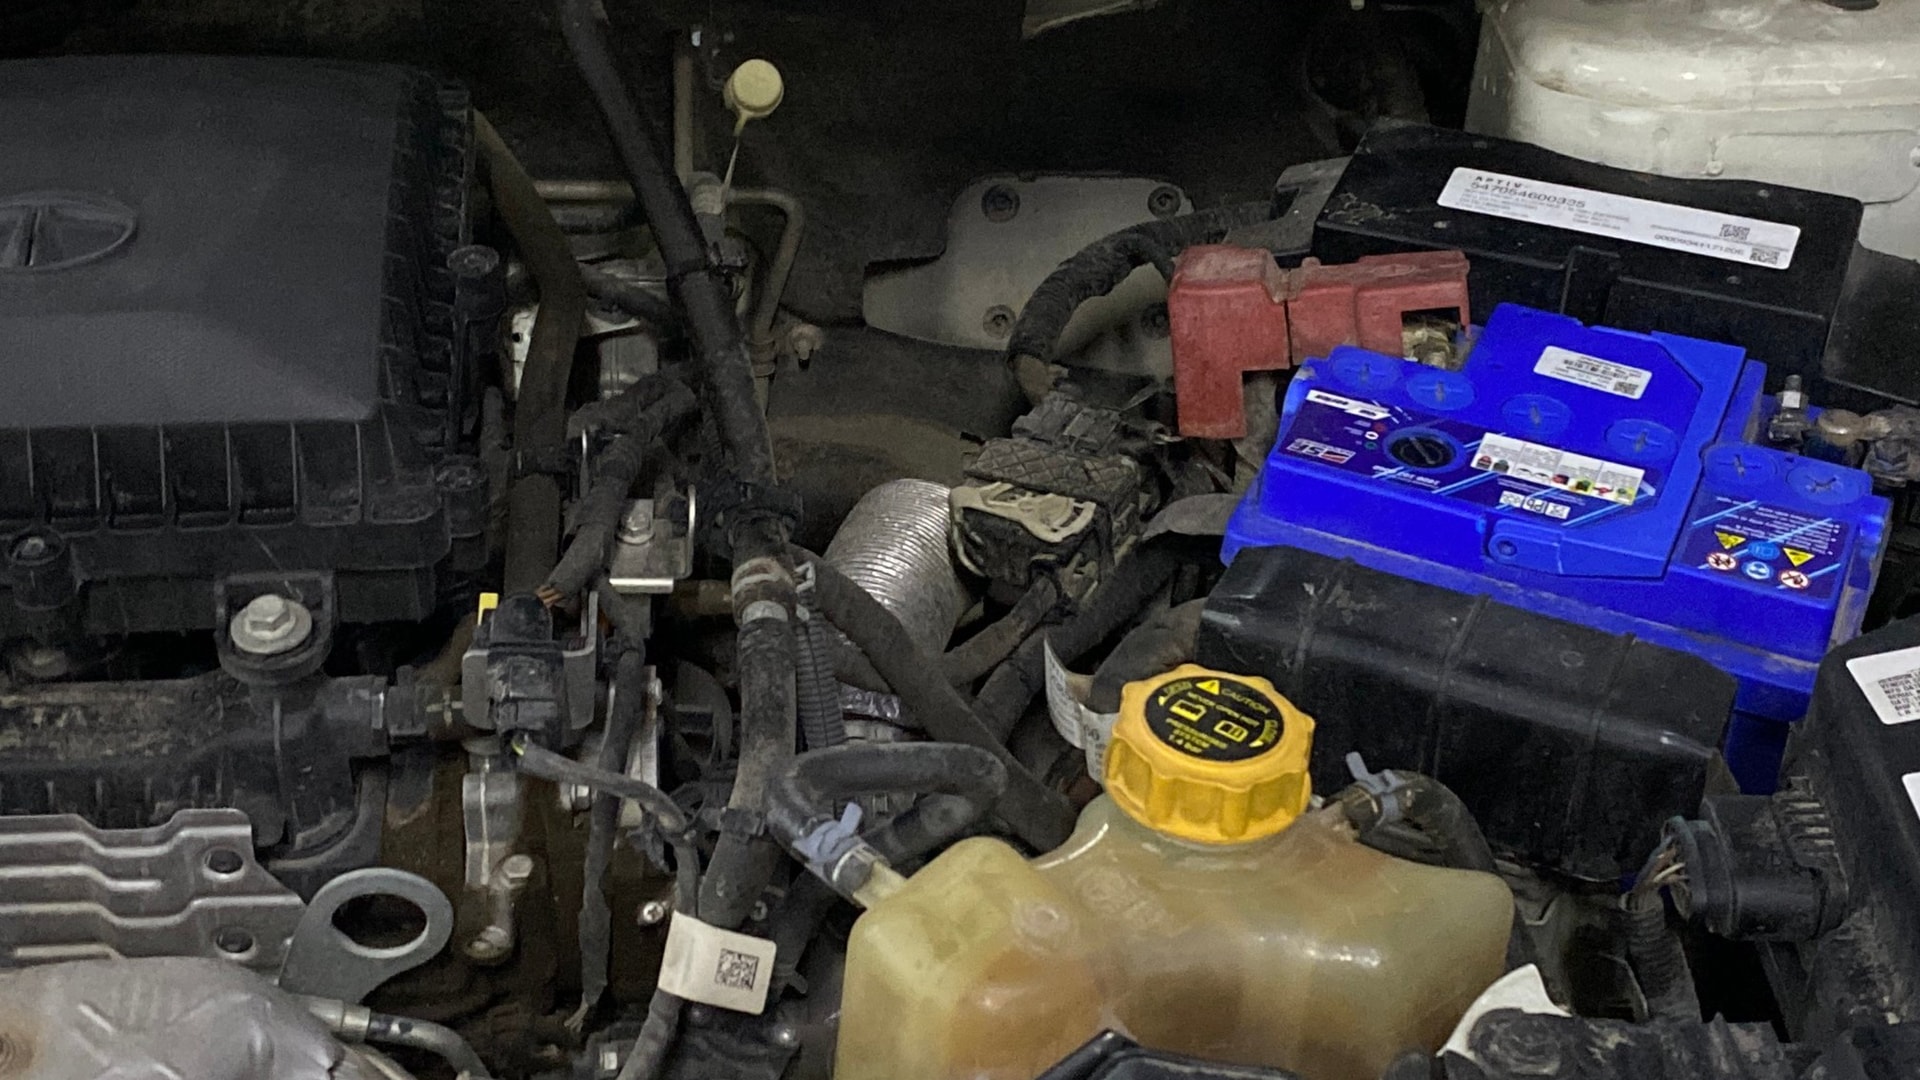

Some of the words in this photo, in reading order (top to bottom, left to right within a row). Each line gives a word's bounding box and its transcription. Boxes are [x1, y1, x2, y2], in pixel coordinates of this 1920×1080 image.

[1475, 175, 1522, 189] APTIV
[1526, 498, 1546, 512] Pb
[1187, 691, 1216, 707] NEVER
[1221, 687, 1272, 715] CAUTION
[1173, 728, 1210, 749] SYSTEM
